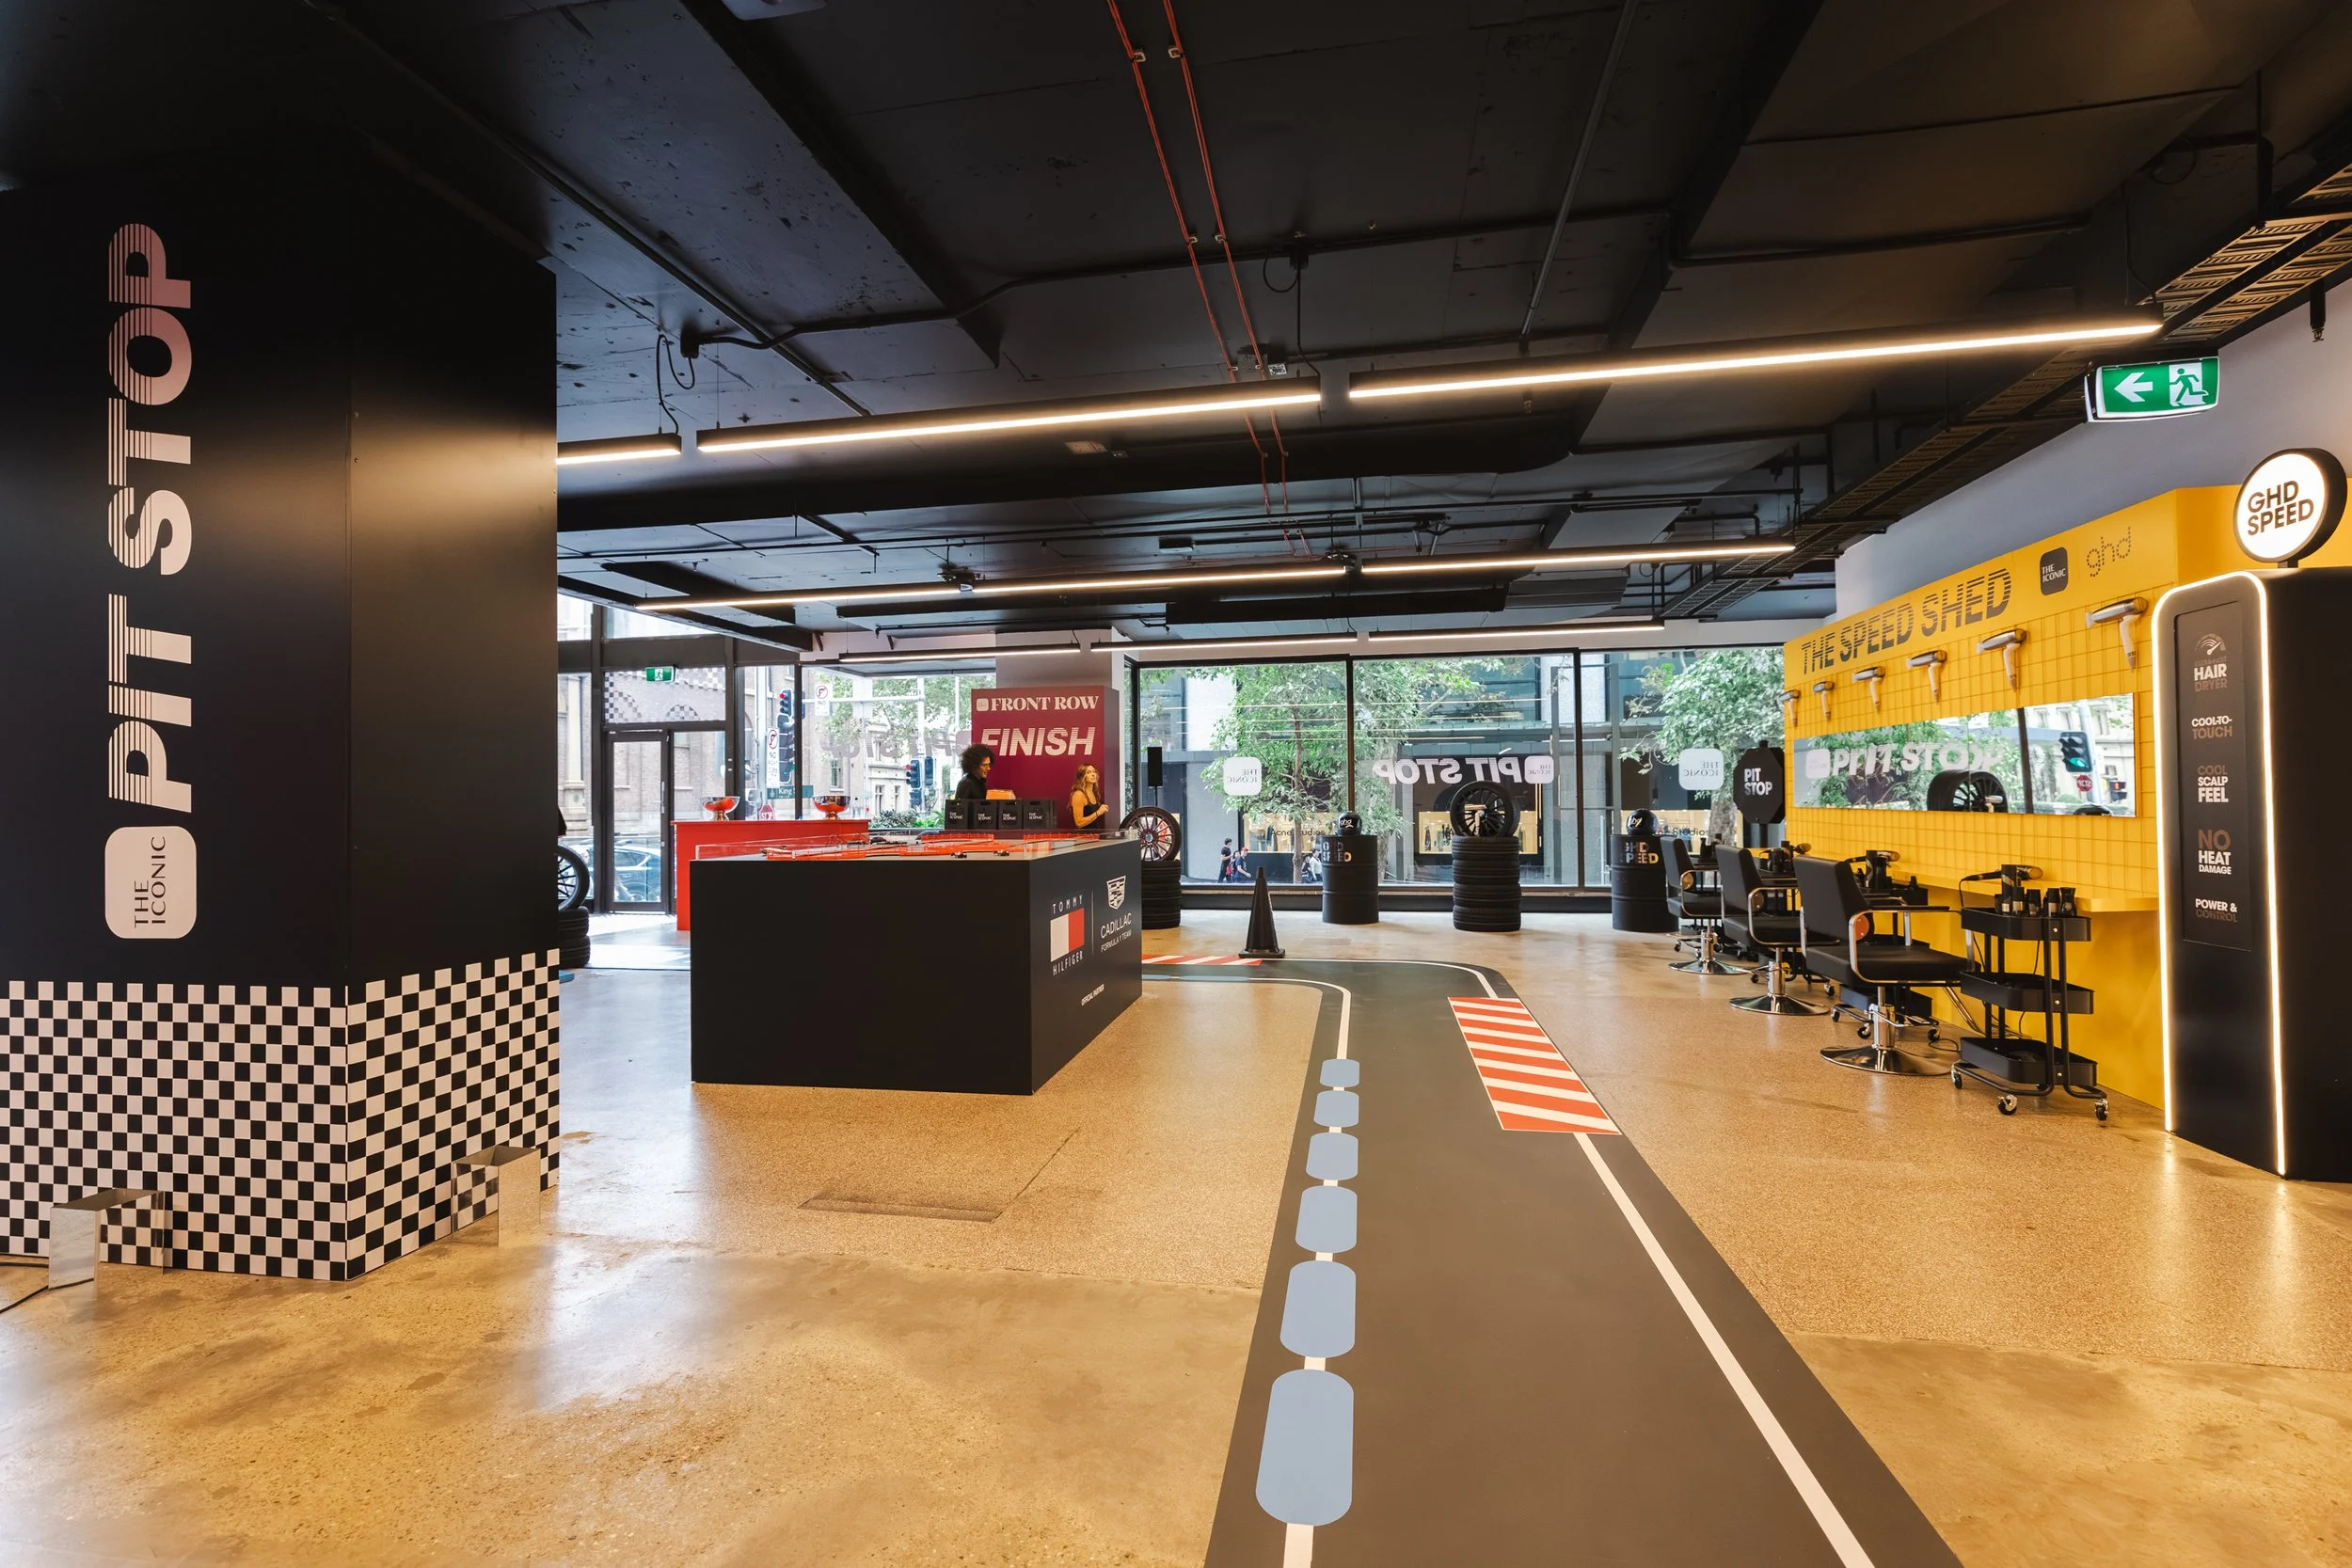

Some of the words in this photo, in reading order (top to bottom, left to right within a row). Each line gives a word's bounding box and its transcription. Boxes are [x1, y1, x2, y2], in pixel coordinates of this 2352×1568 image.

[108, 223, 192, 576] STOP
[2247, 480, 2299, 514] GHD
[2247, 499, 2314, 536] SPEED
[2086, 526, 2131, 578] ghd
[2042, 563, 2055, 575] THE
[2042, 568, 2067, 582] ICONIC
[1802, 631, 1835, 675] THE
[1839, 602, 1914, 663] SPEED
[1921, 567, 2012, 637] SHED
[2193, 663, 2227, 681] HAIR
[2194, 677, 2228, 692] DRYER
[108, 593, 192, 815] PIT
[991, 697, 1050, 711] FRONT
[1055, 695, 1100, 710] ROW
[2191, 715, 2233, 727] COOL-TO-
[2192, 725, 2233, 739] TOUCH
[981, 726, 1096, 756] FINISH
[1744, 768, 1761, 782] PIT
[2197, 765, 2228, 775] COOL
[1744, 781, 1772, 796] STOP
[2198, 776, 2229, 786] SCALP
[778, 787, 792, 796] King
[2198, 786, 2229, 802] FEEL
[2198, 829, 2232, 851] NO
[2198, 850, 2232, 865] HEAT
[2199, 863, 2232, 875] DAMAGE
[151, 836, 167, 925] ICONIC
[134, 879, 150, 929] THE
[1052, 895, 1083, 914] TOMMY
[2195, 898, 2229, 912] POWER
[2230, 902, 2237, 913] &
[2195, 909, 2238, 923] CONTROL
[1100, 912, 1132, 939] CADILLAC
[1101, 937, 1120, 953] FORMULA
[1053, 950, 1083, 976] HILFIGER
